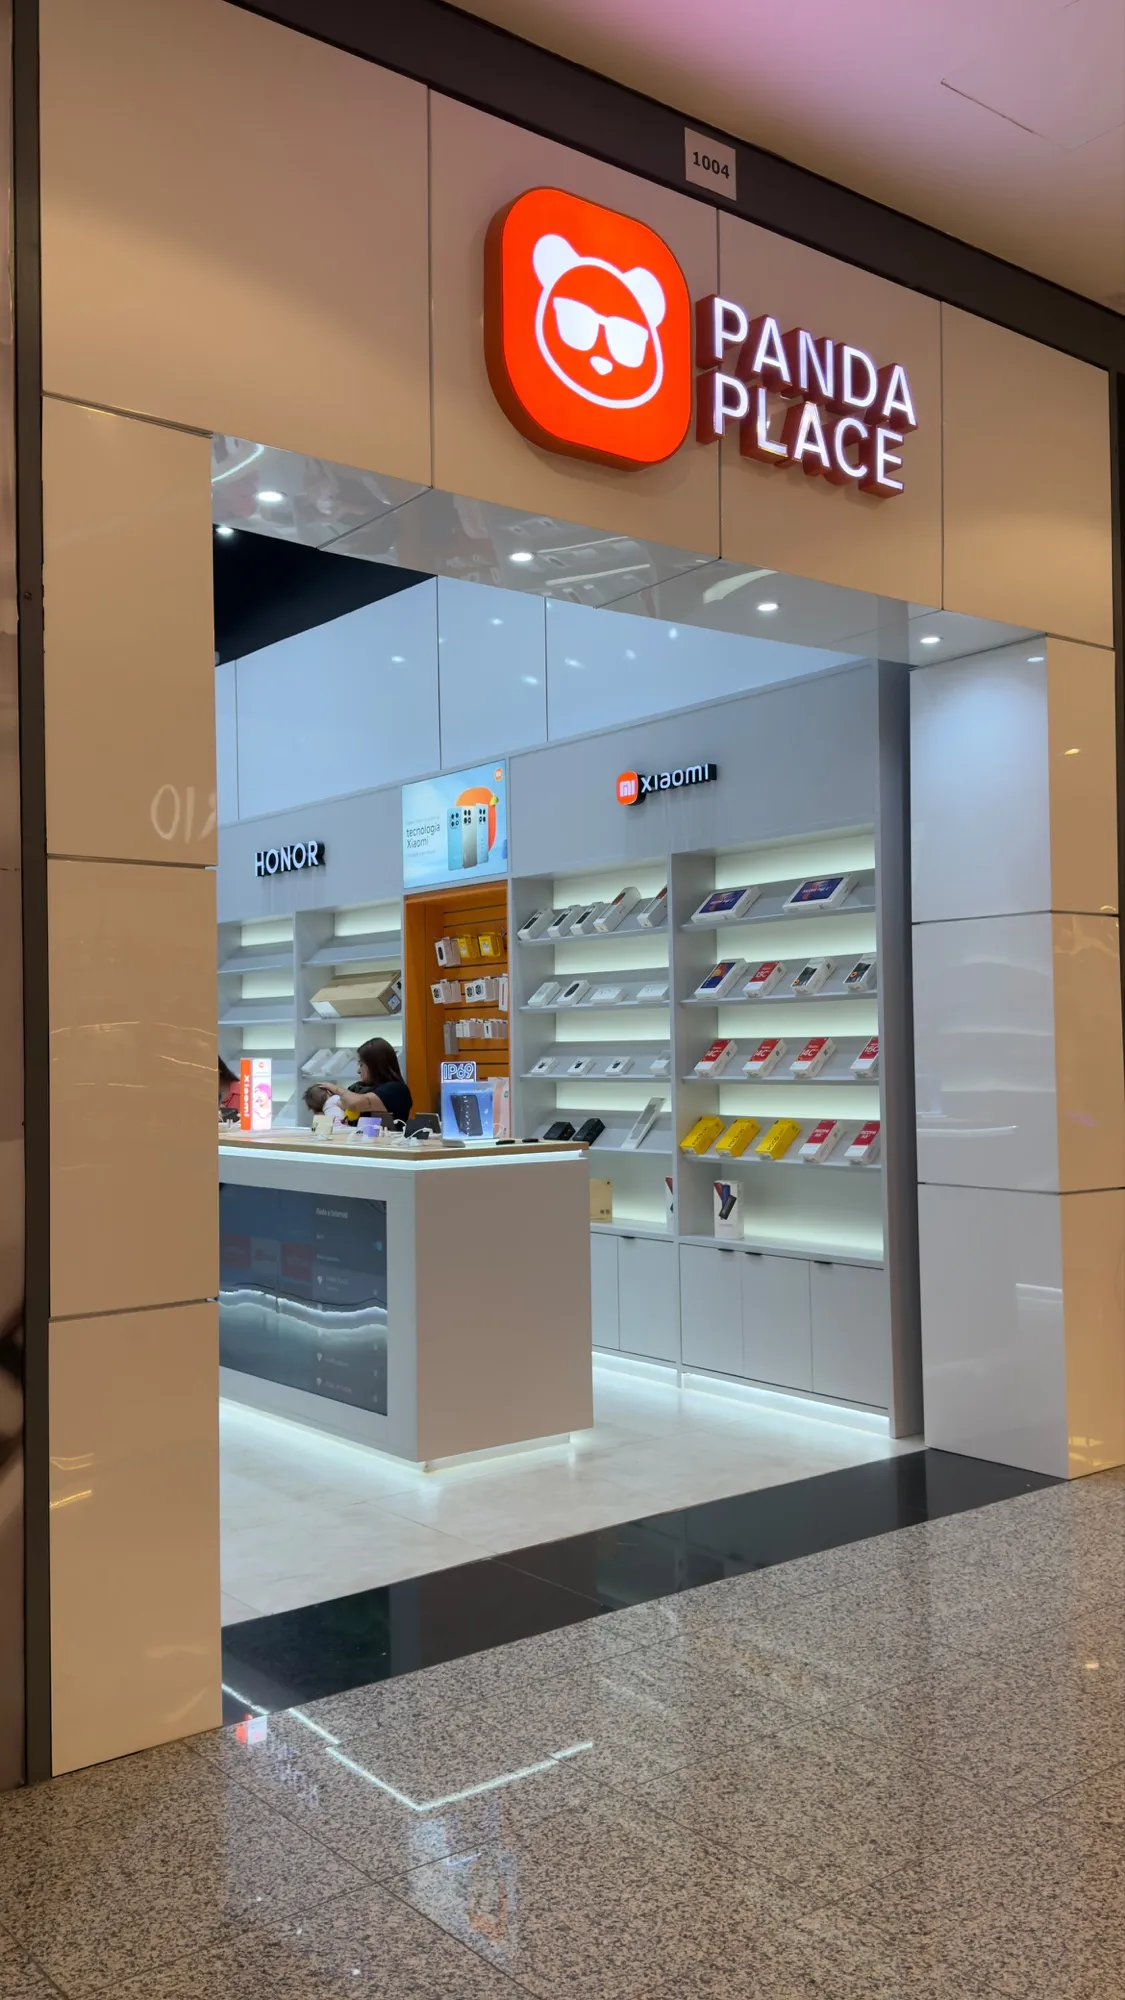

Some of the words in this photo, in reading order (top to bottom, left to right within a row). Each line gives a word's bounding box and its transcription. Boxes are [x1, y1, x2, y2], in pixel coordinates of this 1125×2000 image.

[692, 150, 730, 180] 1004
[711, 296, 917, 426] PANDA
[711, 371, 905, 490] PLACE
[255, 840, 320, 877] HONOR
[443, 1063, 474, 1080] IP69
